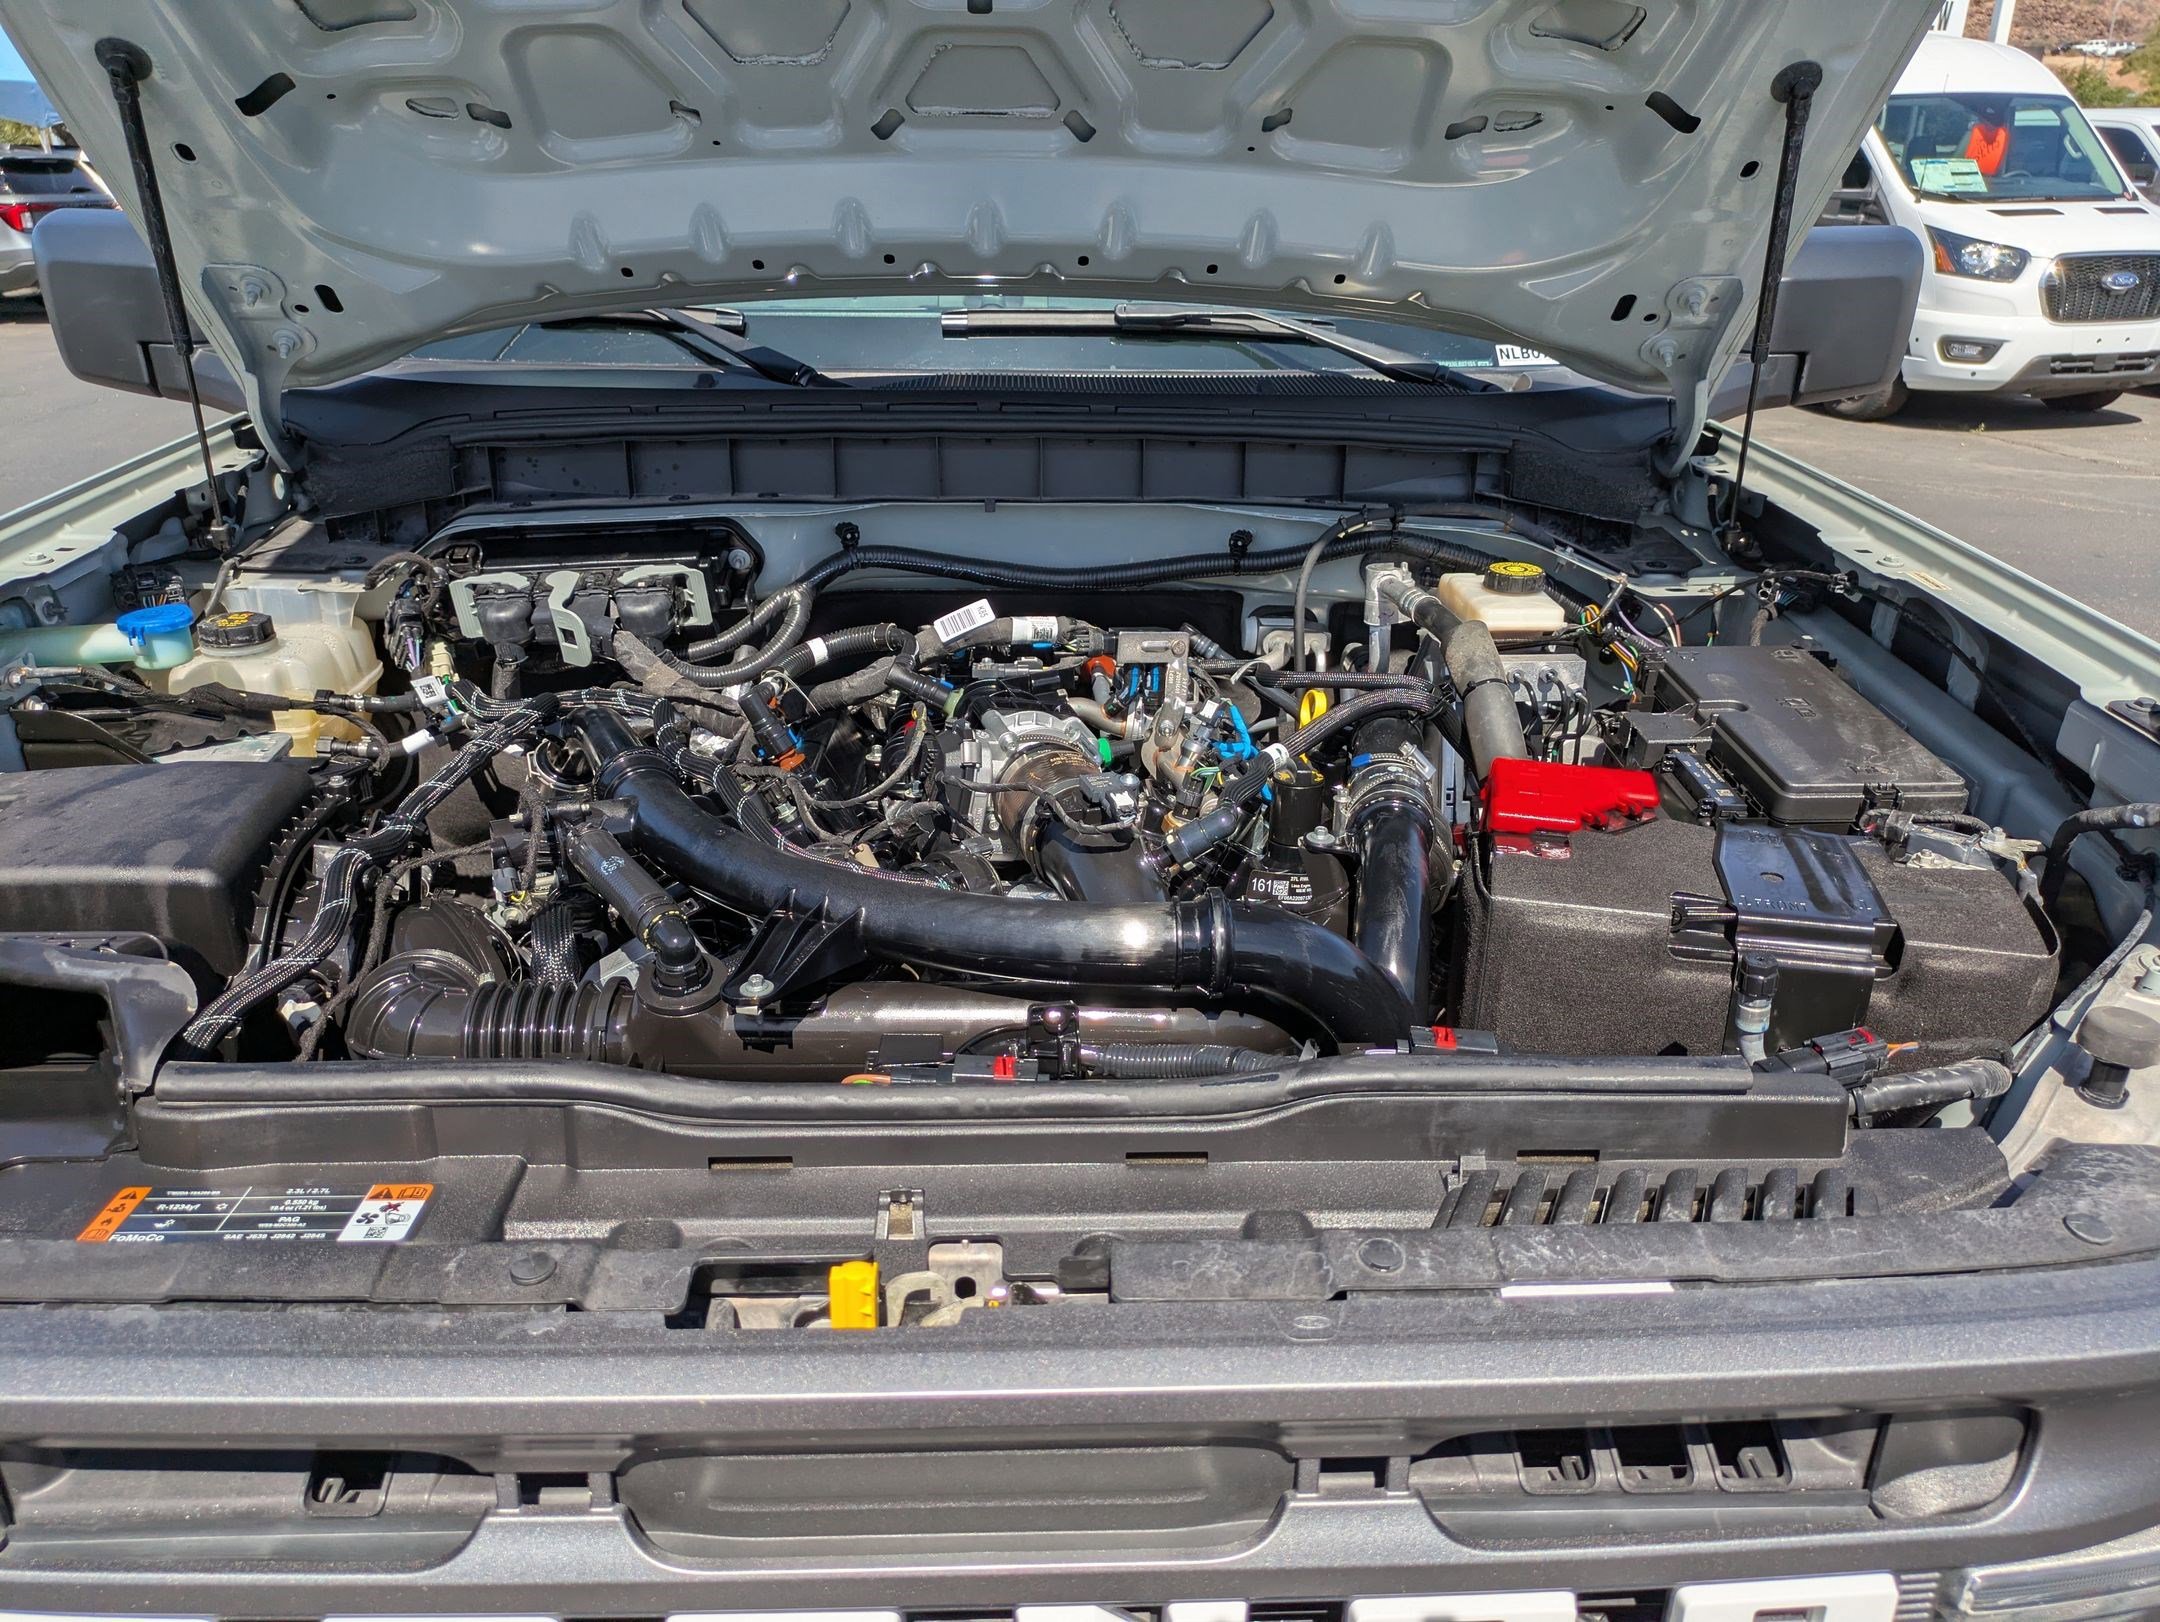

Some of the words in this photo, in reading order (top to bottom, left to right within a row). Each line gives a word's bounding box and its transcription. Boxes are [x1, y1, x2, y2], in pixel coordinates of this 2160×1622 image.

[1252, 878, 1272, 893] 161
[1755, 898, 1807, 912] FRONT
[156, 1203, 202, 1213] R-1234yf
[108, 1233, 165, 1243] FoMoCo
